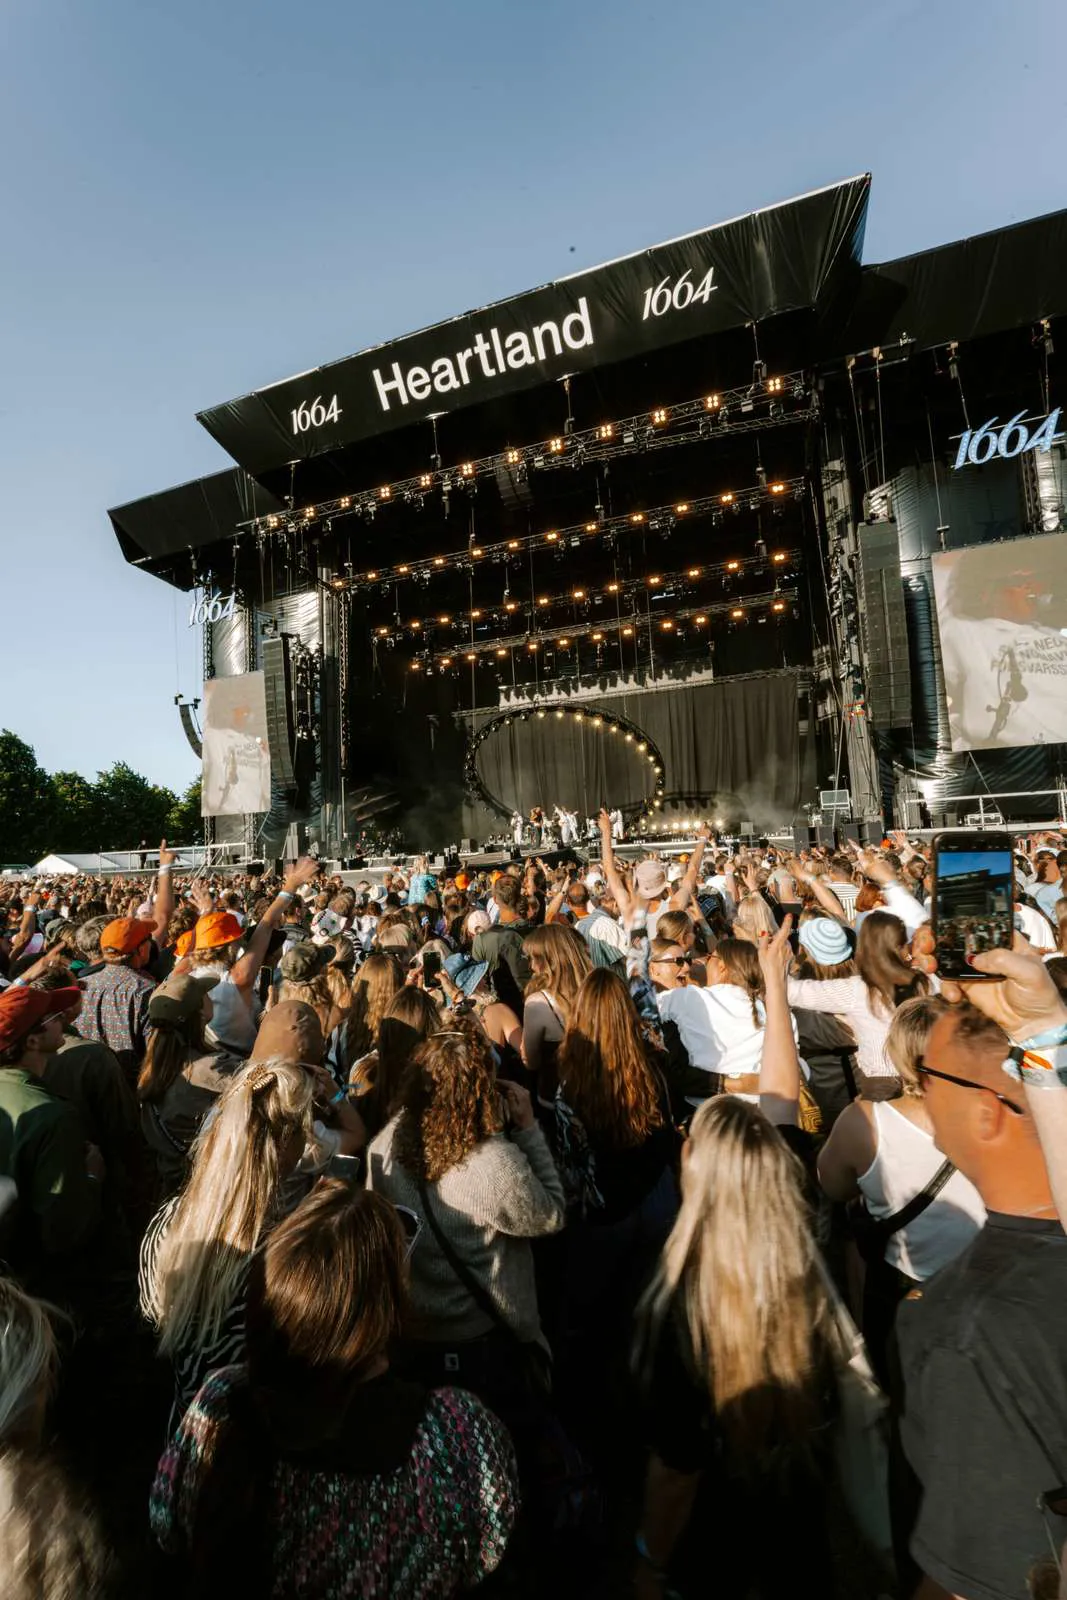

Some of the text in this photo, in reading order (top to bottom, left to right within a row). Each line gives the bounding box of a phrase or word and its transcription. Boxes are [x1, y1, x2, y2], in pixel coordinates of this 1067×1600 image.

[642, 266, 718, 320] 1664
[372, 297, 595, 411] Heartland
[290, 392, 343, 435] 1664
[954, 406, 1065, 470] 1664
[189, 591, 238, 626] 1664
